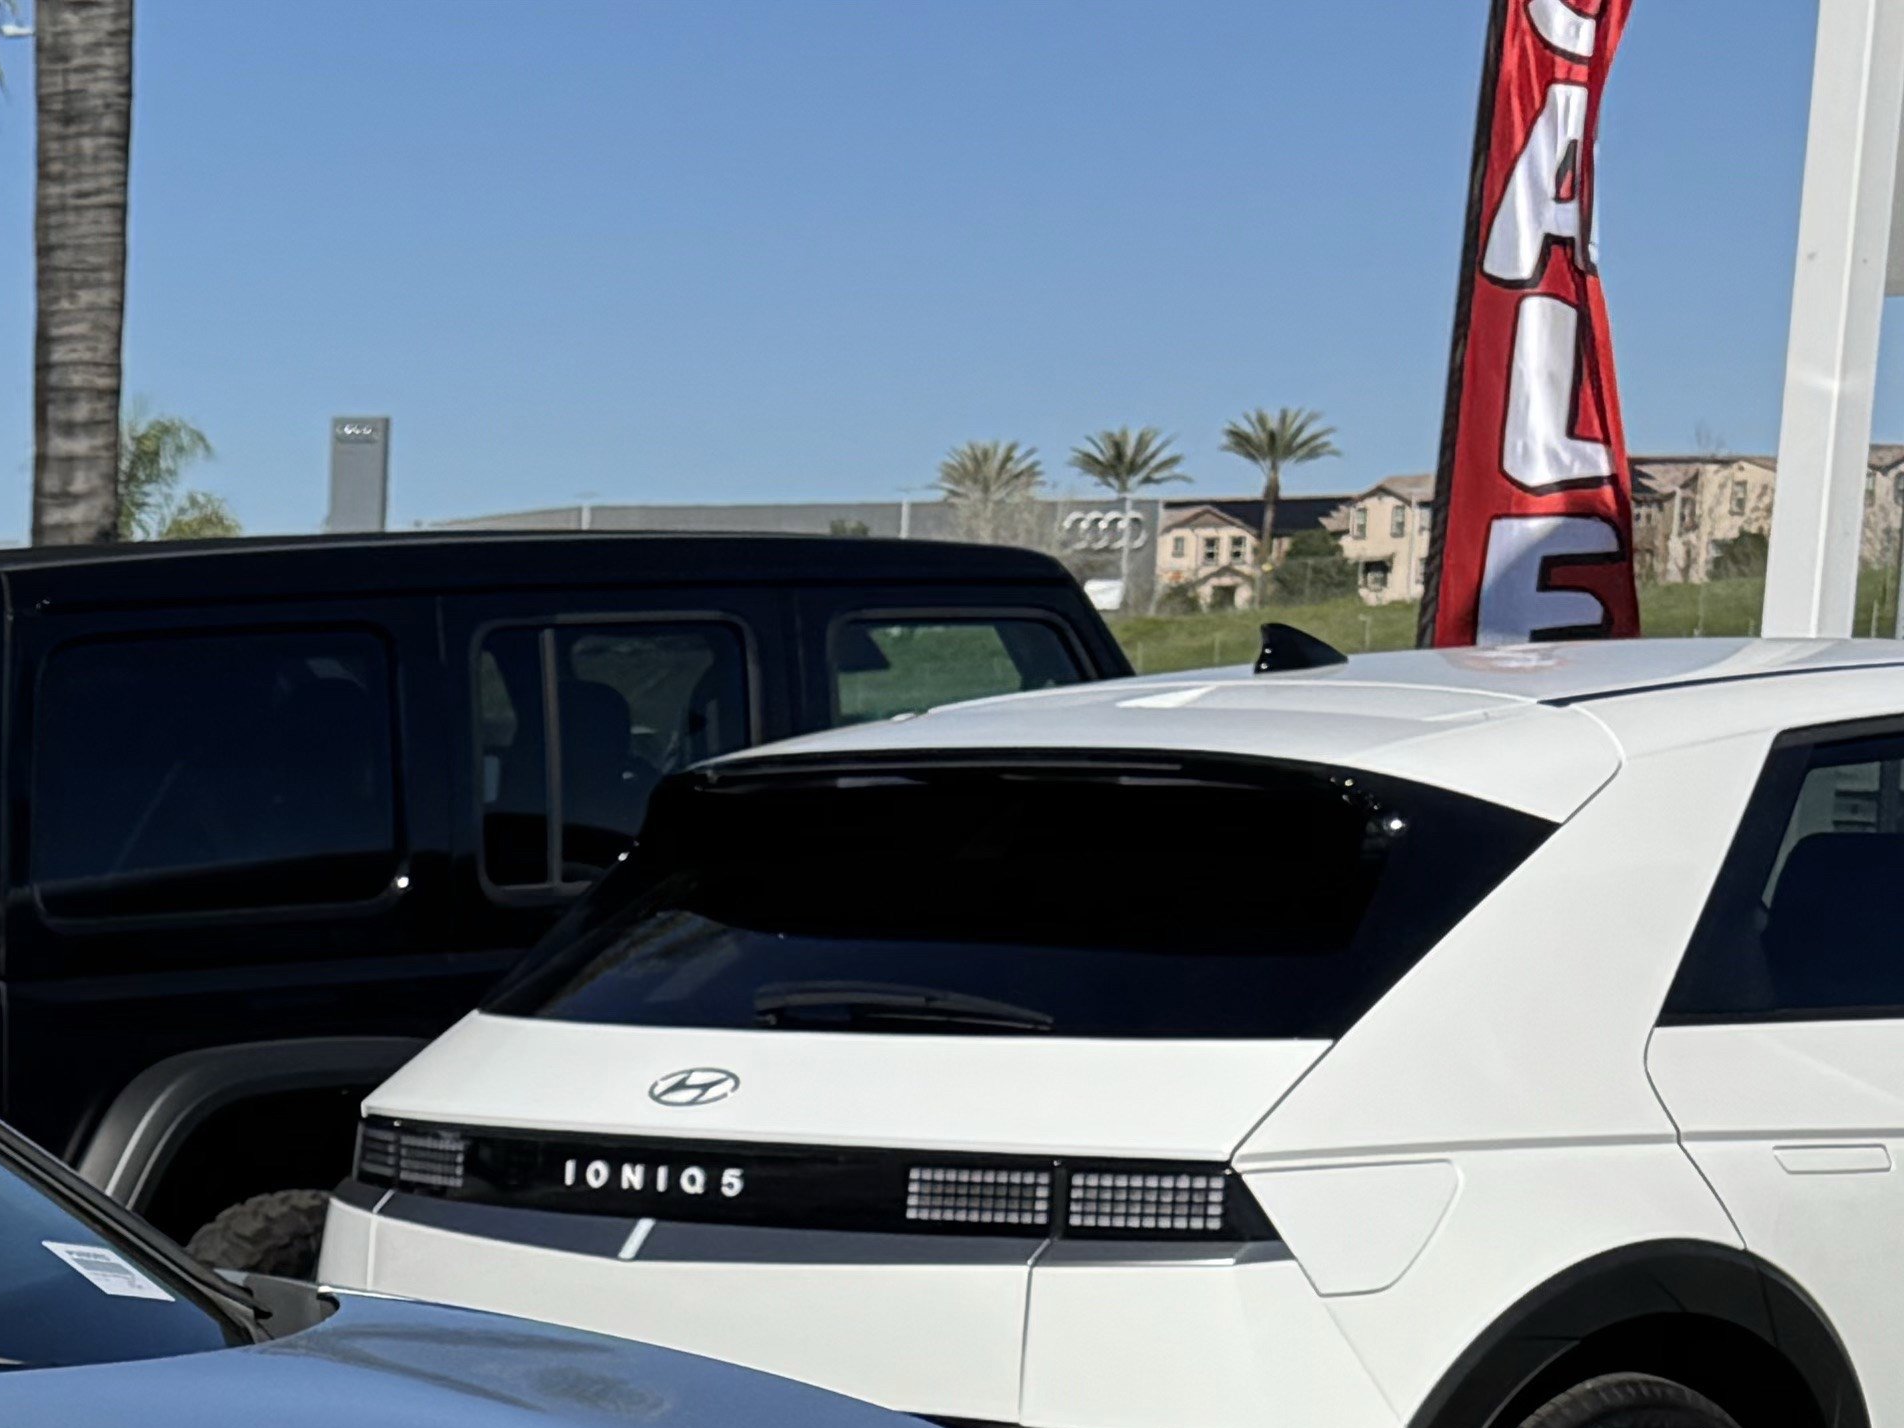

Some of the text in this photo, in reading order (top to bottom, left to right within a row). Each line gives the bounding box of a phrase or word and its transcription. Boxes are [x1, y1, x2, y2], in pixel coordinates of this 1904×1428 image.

[1480, 0, 1622, 645] ALE
[564, 1159, 744, 1197] IONIQ 5
